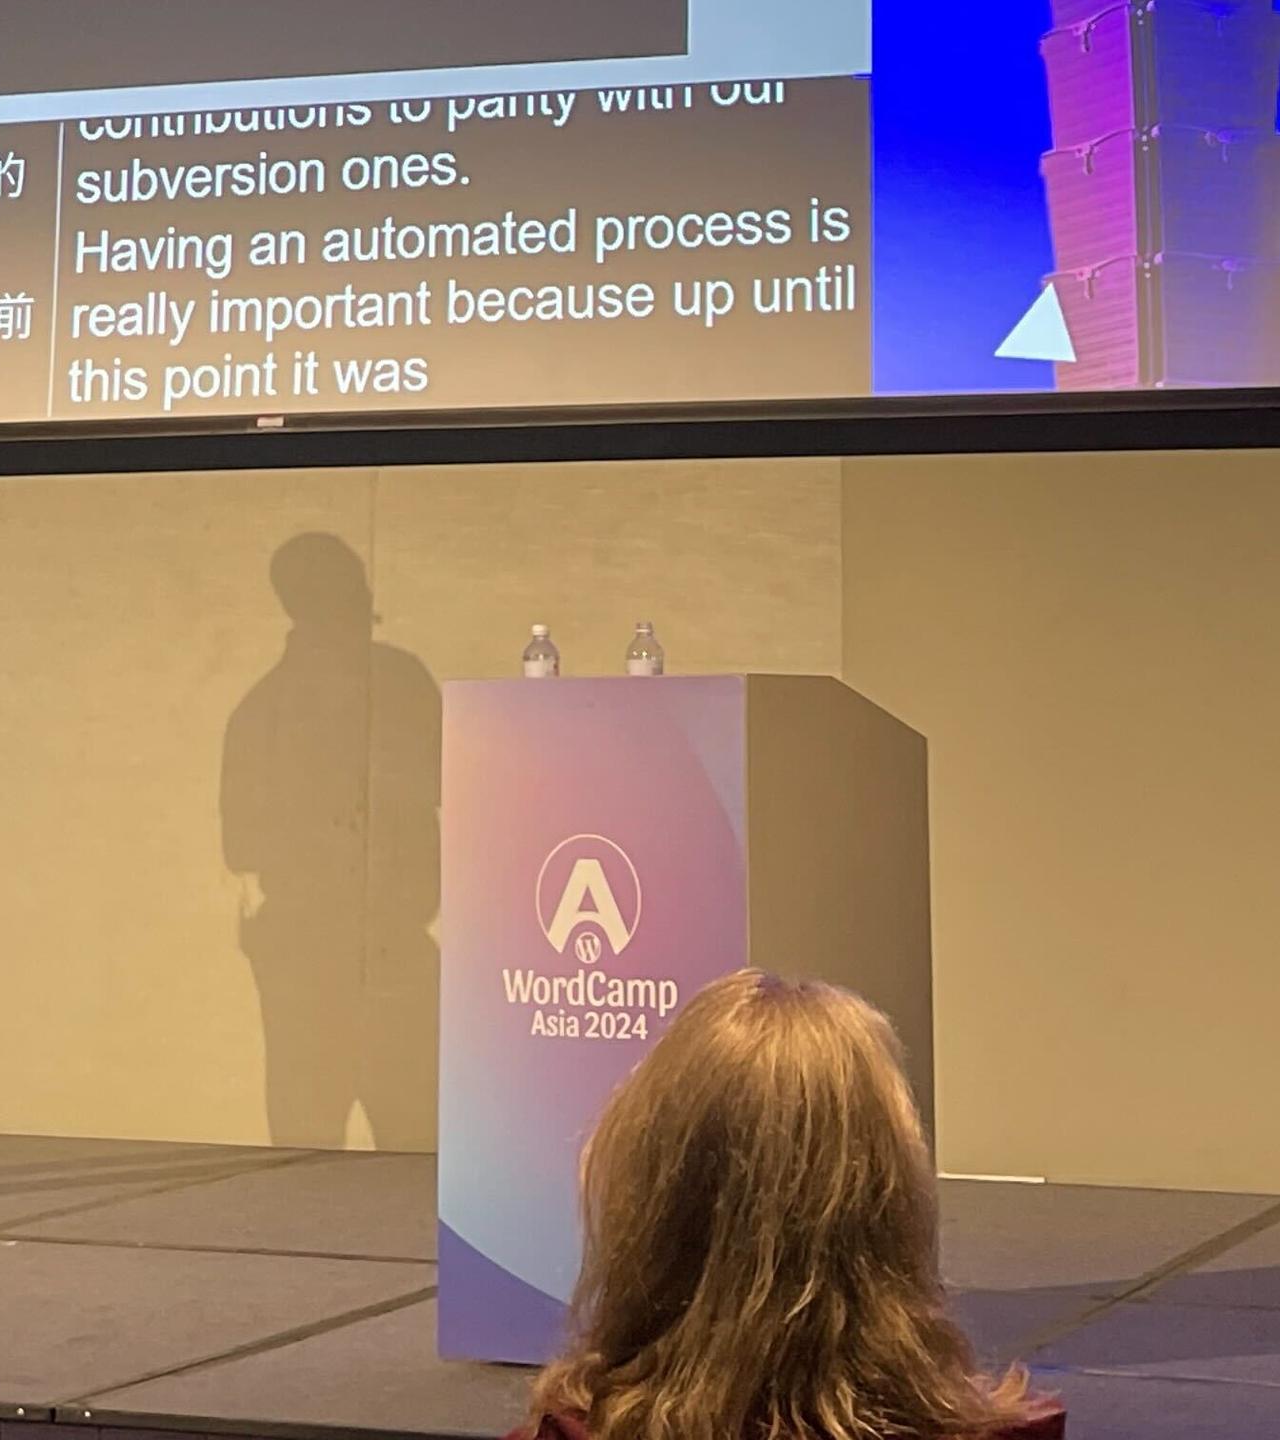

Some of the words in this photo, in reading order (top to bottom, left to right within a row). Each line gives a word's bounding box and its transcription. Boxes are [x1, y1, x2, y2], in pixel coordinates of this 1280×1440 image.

[76, 152, 325, 204] subversion
[341, 152, 470, 191] ones.
[75, 226, 232, 279] Having
[249, 229, 305, 265] an
[322, 208, 576, 262] automated
[595, 209, 792, 263] process
[810, 198, 851, 242] is
[71, 291, 195, 347] really
[210, 280, 432, 342] important
[447, 279, 655, 324] because
[673, 279, 735, 328] up
[752, 264, 856, 313] until
[68, 357, 148, 403] this
[163, 353, 277, 411] point
[292, 350, 319, 395] it
[333, 357, 429, 394] was
[502, 969, 678, 1017] WordCamp
[531, 1010, 579, 1038] Asia
[585, 1011, 648, 1040] 2024
